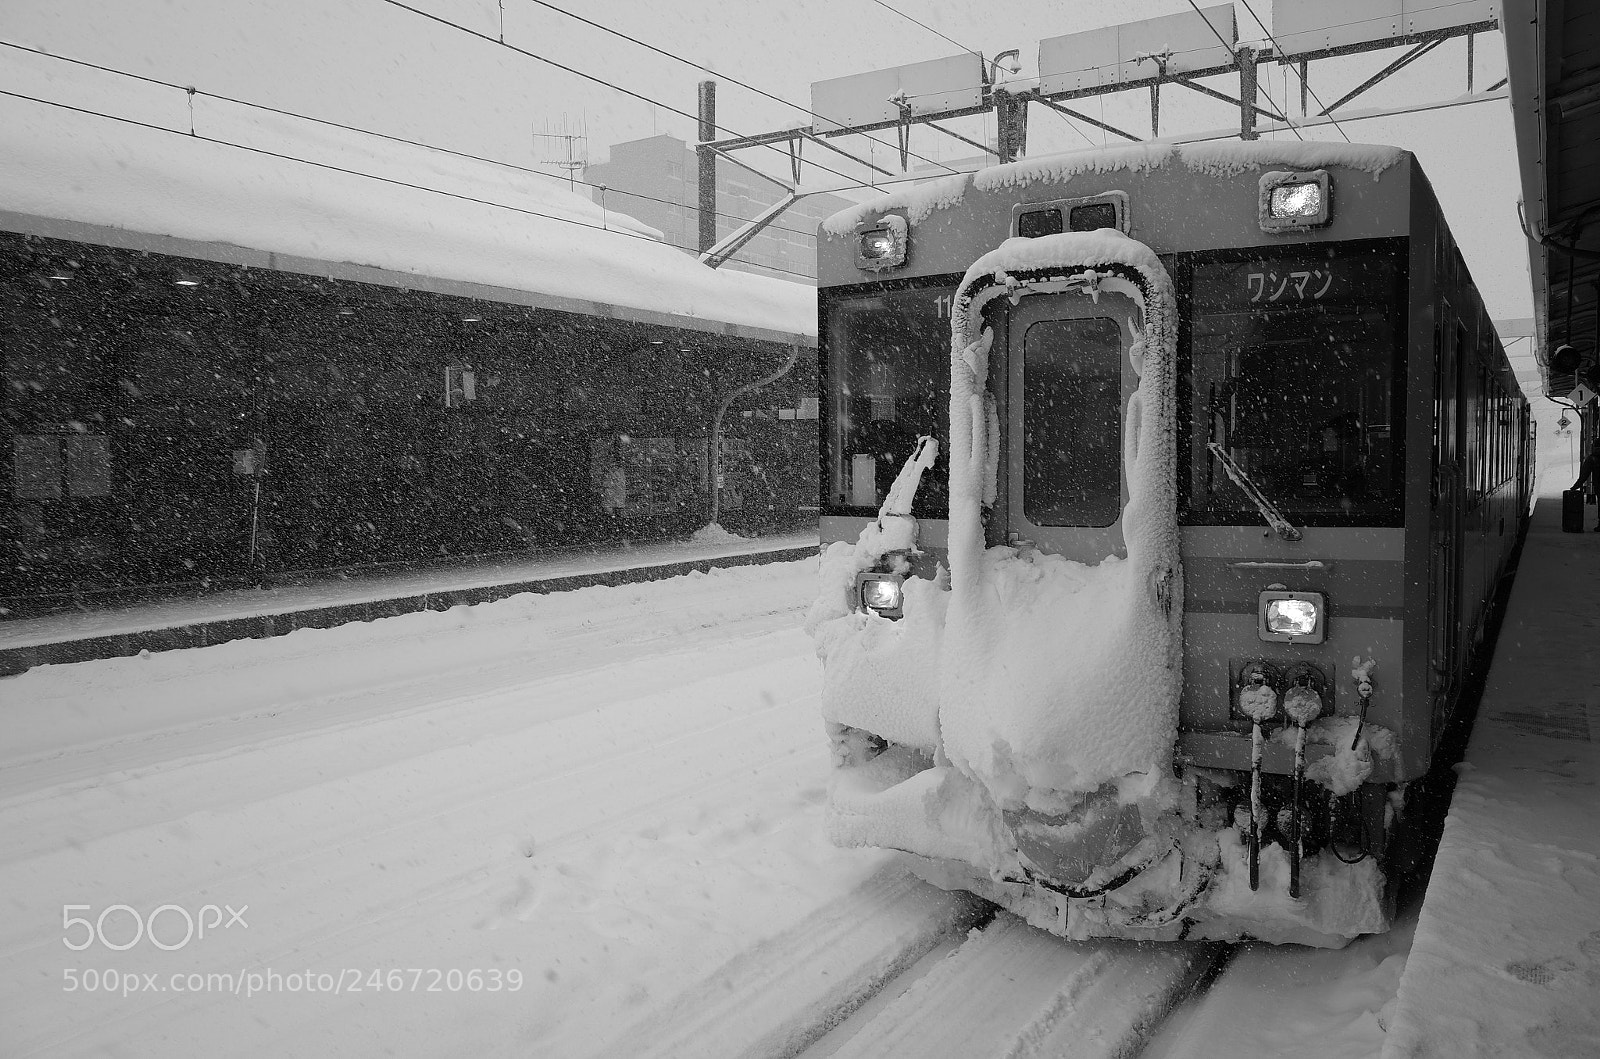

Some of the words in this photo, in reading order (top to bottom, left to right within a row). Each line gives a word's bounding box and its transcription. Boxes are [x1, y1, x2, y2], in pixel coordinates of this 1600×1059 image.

[1247, 269, 1332, 302] ワンマン
[1578, 390, 1584, 401] 1
